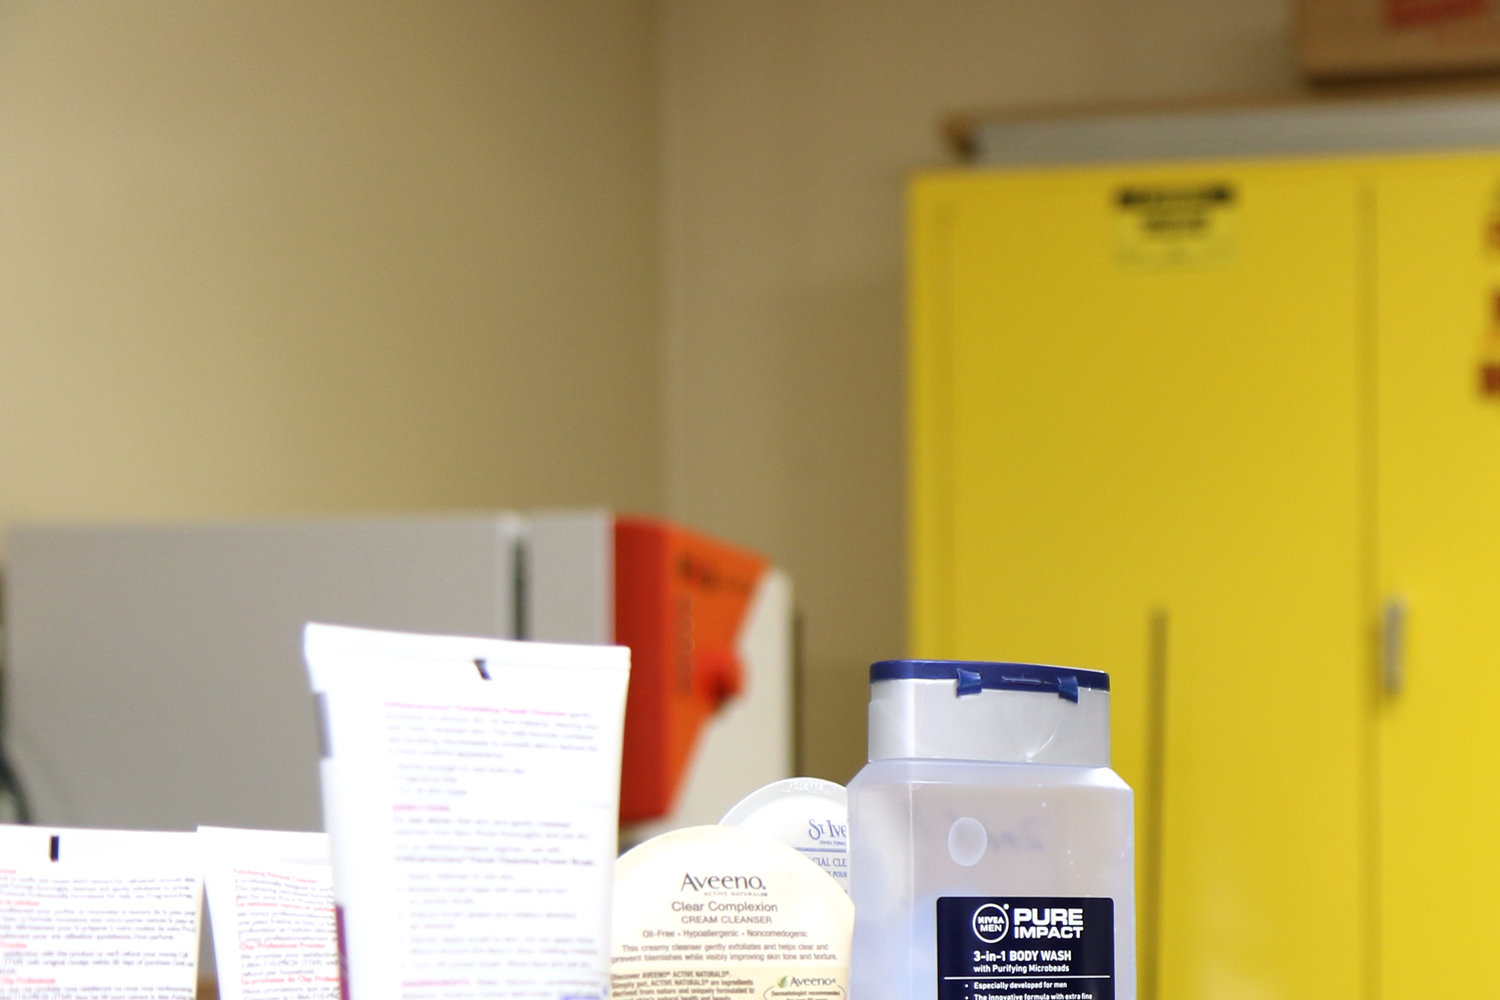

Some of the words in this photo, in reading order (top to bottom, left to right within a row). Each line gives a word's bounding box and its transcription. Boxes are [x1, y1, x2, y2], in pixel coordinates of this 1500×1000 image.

[978, 916, 1005, 925] NIVEA
[1014, 908, 1083, 926] PURE
[1014, 927, 1083, 939] IMPACT
[973, 950, 1006, 962] 3-in-1
[1009, 950, 1038, 961] BODY
[1040, 950, 1071, 961] WASH
[973, 964, 991, 973] with
[992, 964, 1027, 974] Purifying
[1028, 964, 1070, 972] Microbeads
[973, 981, 1009, 990] Especially
[1009, 981, 1043, 989] developed
[1024, 993, 1050, 1000] formula
